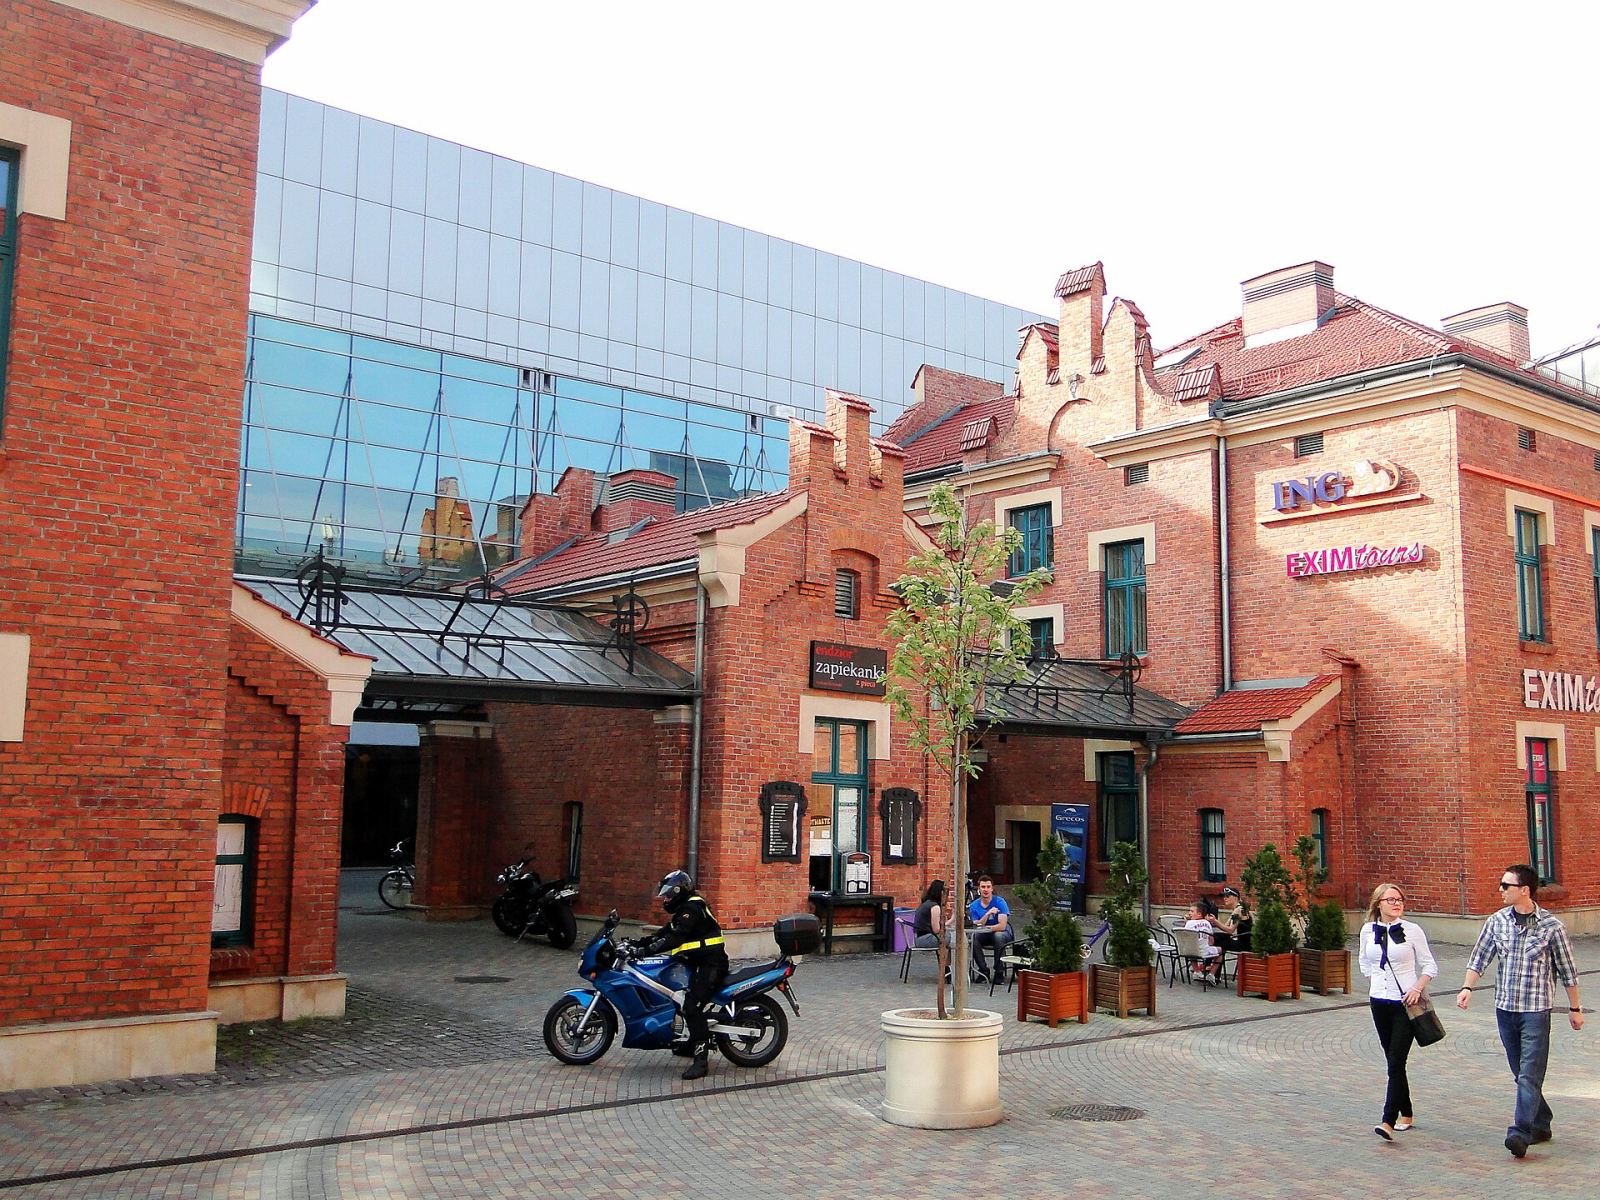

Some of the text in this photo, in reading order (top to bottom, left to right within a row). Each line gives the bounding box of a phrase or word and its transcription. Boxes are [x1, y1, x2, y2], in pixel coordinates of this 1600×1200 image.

[1272, 471, 1345, 510] ING
[1286, 542, 1423, 577] EXIMtours
[816, 661, 885, 680] zapiekanki
[1055, 814, 1085, 822] Grecos
